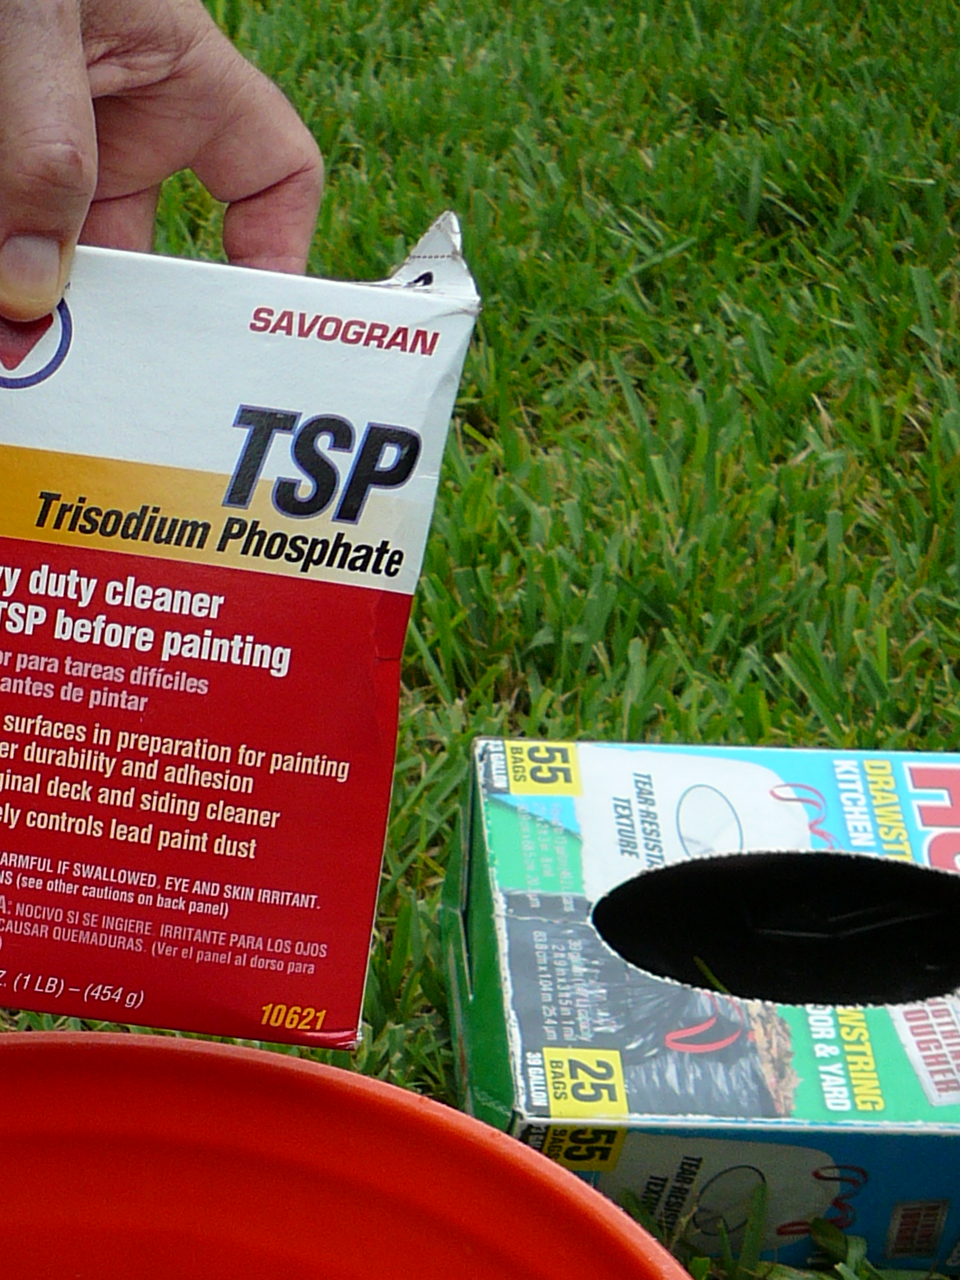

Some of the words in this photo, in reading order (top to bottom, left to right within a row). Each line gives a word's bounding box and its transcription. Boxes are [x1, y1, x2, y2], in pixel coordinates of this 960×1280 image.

[248, 306, 440, 357] SAVOGRAN
[221, 404, 423, 525] TSP
[33, 491, 212, 552] Trisodium
[216, 516, 406, 579] Phosphate
[28, 564, 97, 607] duty
[104, 576, 225, 619] cleaner
[53, 609, 155, 652] before
[161, 629, 292, 678] painting
[0, 676, 55, 699] antes
[59, 681, 84, 703] de
[88, 687, 149, 712] pintar
[15, 651, 60, 676] para
[64, 656, 126, 683] tareas
[129, 665, 209, 695] difíciles
[3, 714, 87, 742] surfaces
[92, 722, 111, 746] in
[116, 731, 232, 763] preparation
[237, 744, 266, 768] for
[269, 751, 350, 783] painting
[23, 741, 117, 777] durability
[121, 759, 159, 780] and
[163, 764, 254, 794] adhesion
[508, 746, 526, 783] BAGS
[526, 746, 572, 785] 55
[46, 775, 93, 802] deck
[97, 787, 135, 808] and
[139, 790, 201, 820] siding
[206, 800, 281, 828] cleaner
[831, 760, 876, 847] KITCHEN
[25, 810, 104, 838] controls
[109, 818, 153, 845] lead
[157, 829, 209, 853] paint
[213, 834, 257, 859] dust
[611, 797, 639, 860] TEXTURE
[16, 872, 44, 890] (see
[46, 878, 80, 895] other
[81, 885, 135, 904] cautions
[137, 893, 154, 906] on
[156, 893, 186, 911] back
[188, 900, 229, 919] panel)
[56, 860, 70, 875] IF
[164, 876, 190, 893] EYE
[191, 880, 221, 897] AND
[222, 884, 255, 902] SKIN
[257, 888, 321, 910] IRRITANT.
[15, 902, 64, 923] NOCIVO
[66, 910, 80, 925] SI
[82, 912, 99, 928] SE
[159, 923, 227, 945] IRRITANTE
[229, 933, 264, 950] PARA
[266, 937, 292, 954] LOS
[294, 941, 328, 958] OJOS
[151, 941, 179, 957] (Ver
[181, 946, 194, 959] el
[195, 950, 232, 965] panel
[234, 953, 247, 967] al
[249, 954, 285, 971] dorso
[286, 961, 315, 975] para
[13, 973, 31, 992] (1
[34, 975, 65, 998] LB)
[83, 983, 124, 1003] (454
[124, 990, 144, 1009] g)
[261, 1003, 327, 1030] 10621
[526, 1052, 541, 1066] 39
[813, 1043, 839, 1058] &
[527, 1067, 547, 1107] GALLON
[548, 1060, 568, 1100] BAGS
[567, 1058, 616, 1104] 25
[817, 1062, 851, 1112] YARD
[562, 1128, 618, 1162] 55
